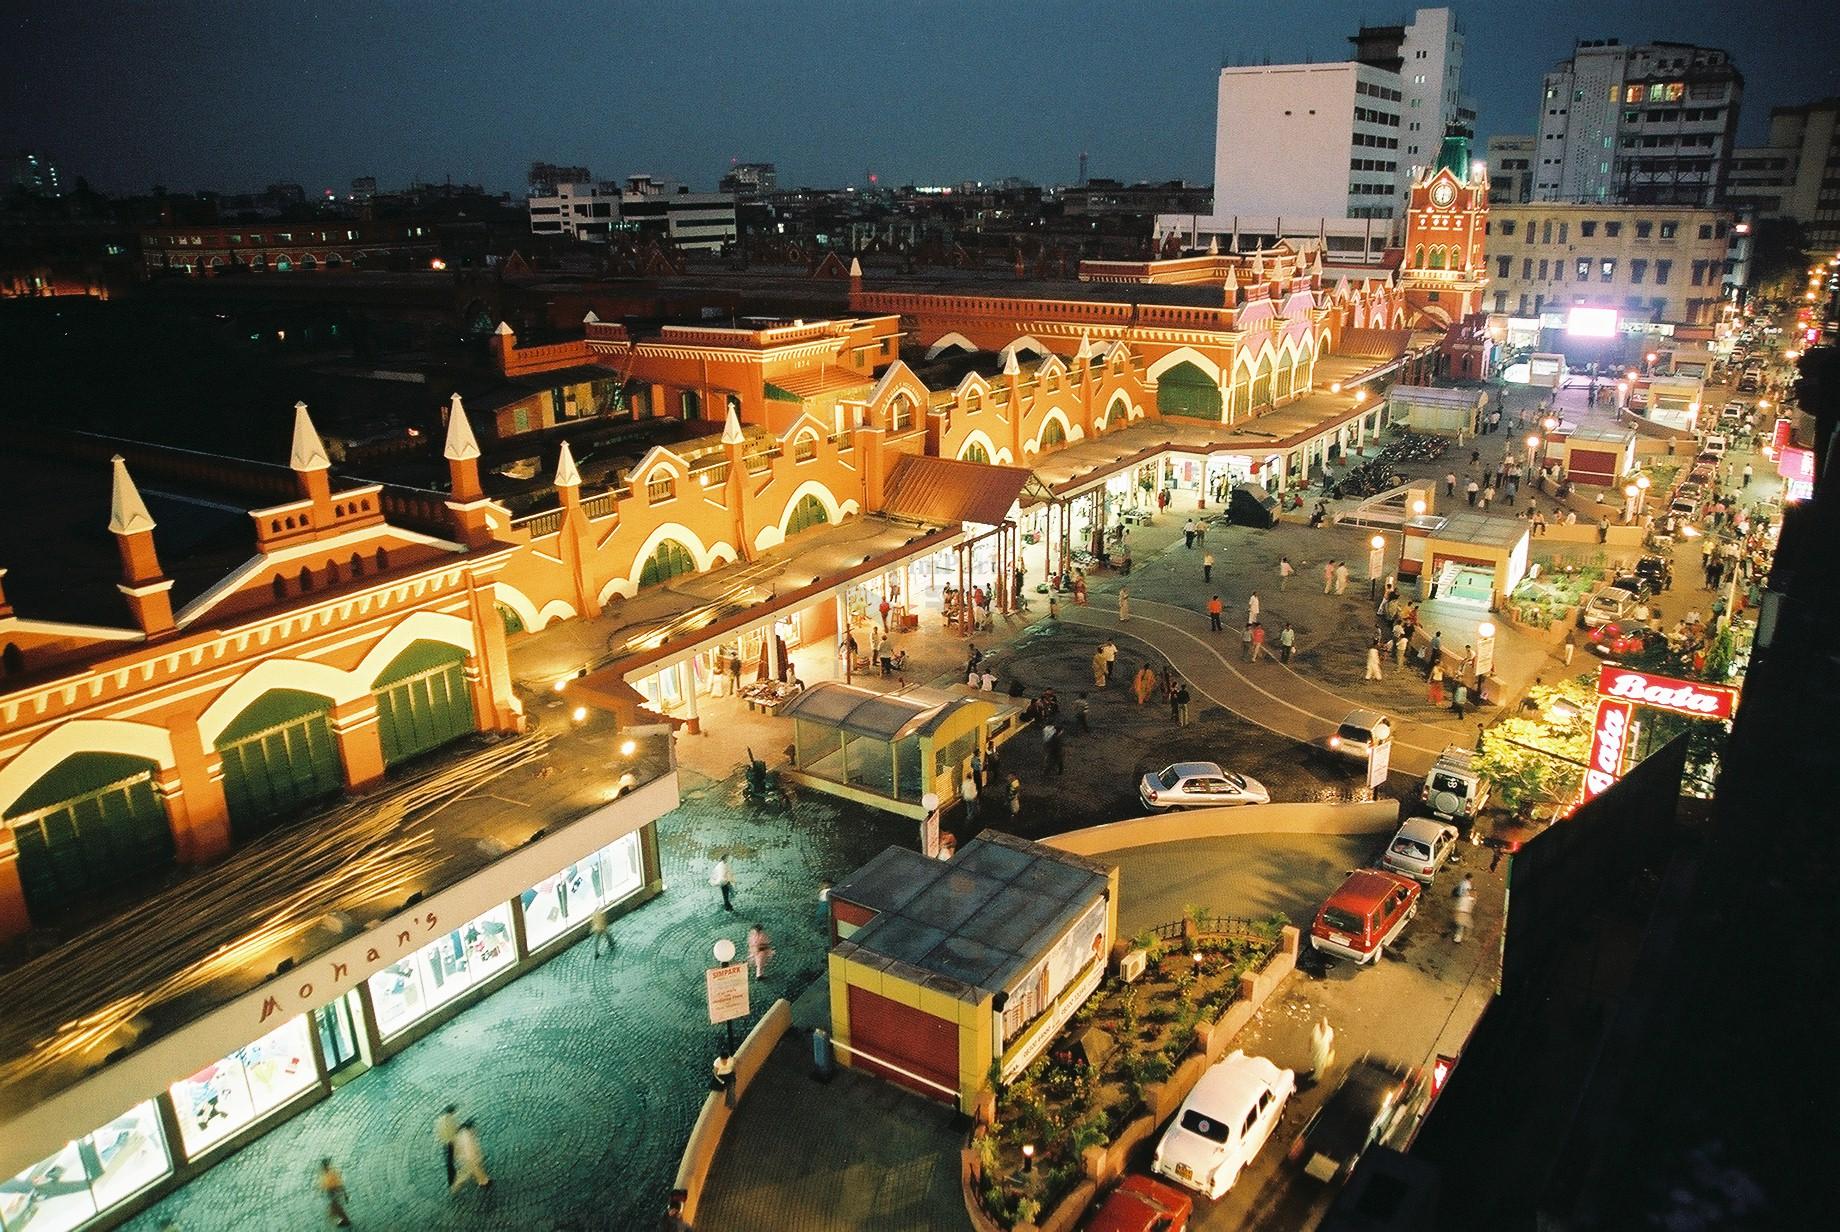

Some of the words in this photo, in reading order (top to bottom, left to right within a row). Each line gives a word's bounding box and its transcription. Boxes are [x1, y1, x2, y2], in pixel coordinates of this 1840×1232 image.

[1608, 674, 1720, 712] Bata
[259, 911, 438, 1023] Mohan's
[712, 966, 741, 979] SIMPARK
